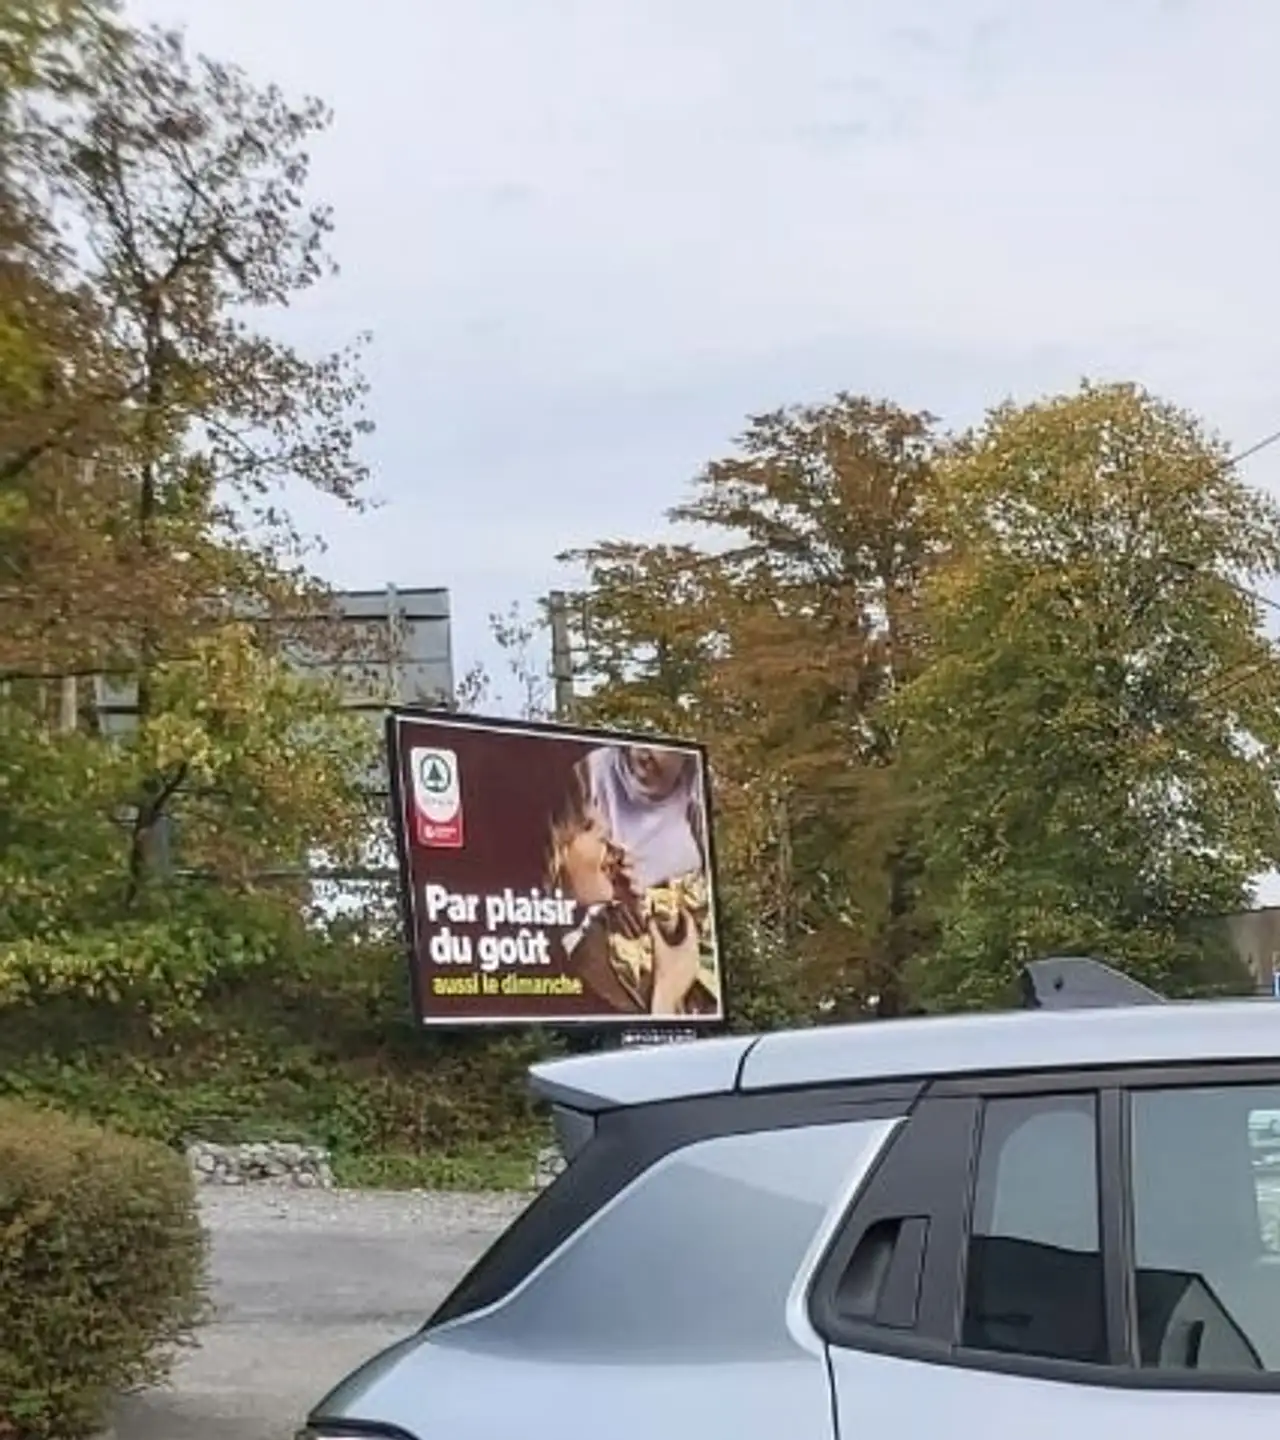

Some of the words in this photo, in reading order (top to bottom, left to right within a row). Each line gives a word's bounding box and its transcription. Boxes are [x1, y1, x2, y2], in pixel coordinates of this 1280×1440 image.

[425, 884, 480, 923] Par
[485, 887, 577, 931] plaisir
[429, 926, 473, 965] du
[477, 928, 551, 973] goût
[432, 973, 479, 995] aussi
[482, 973, 500, 995] le
[500, 973, 584, 995] dimanche
